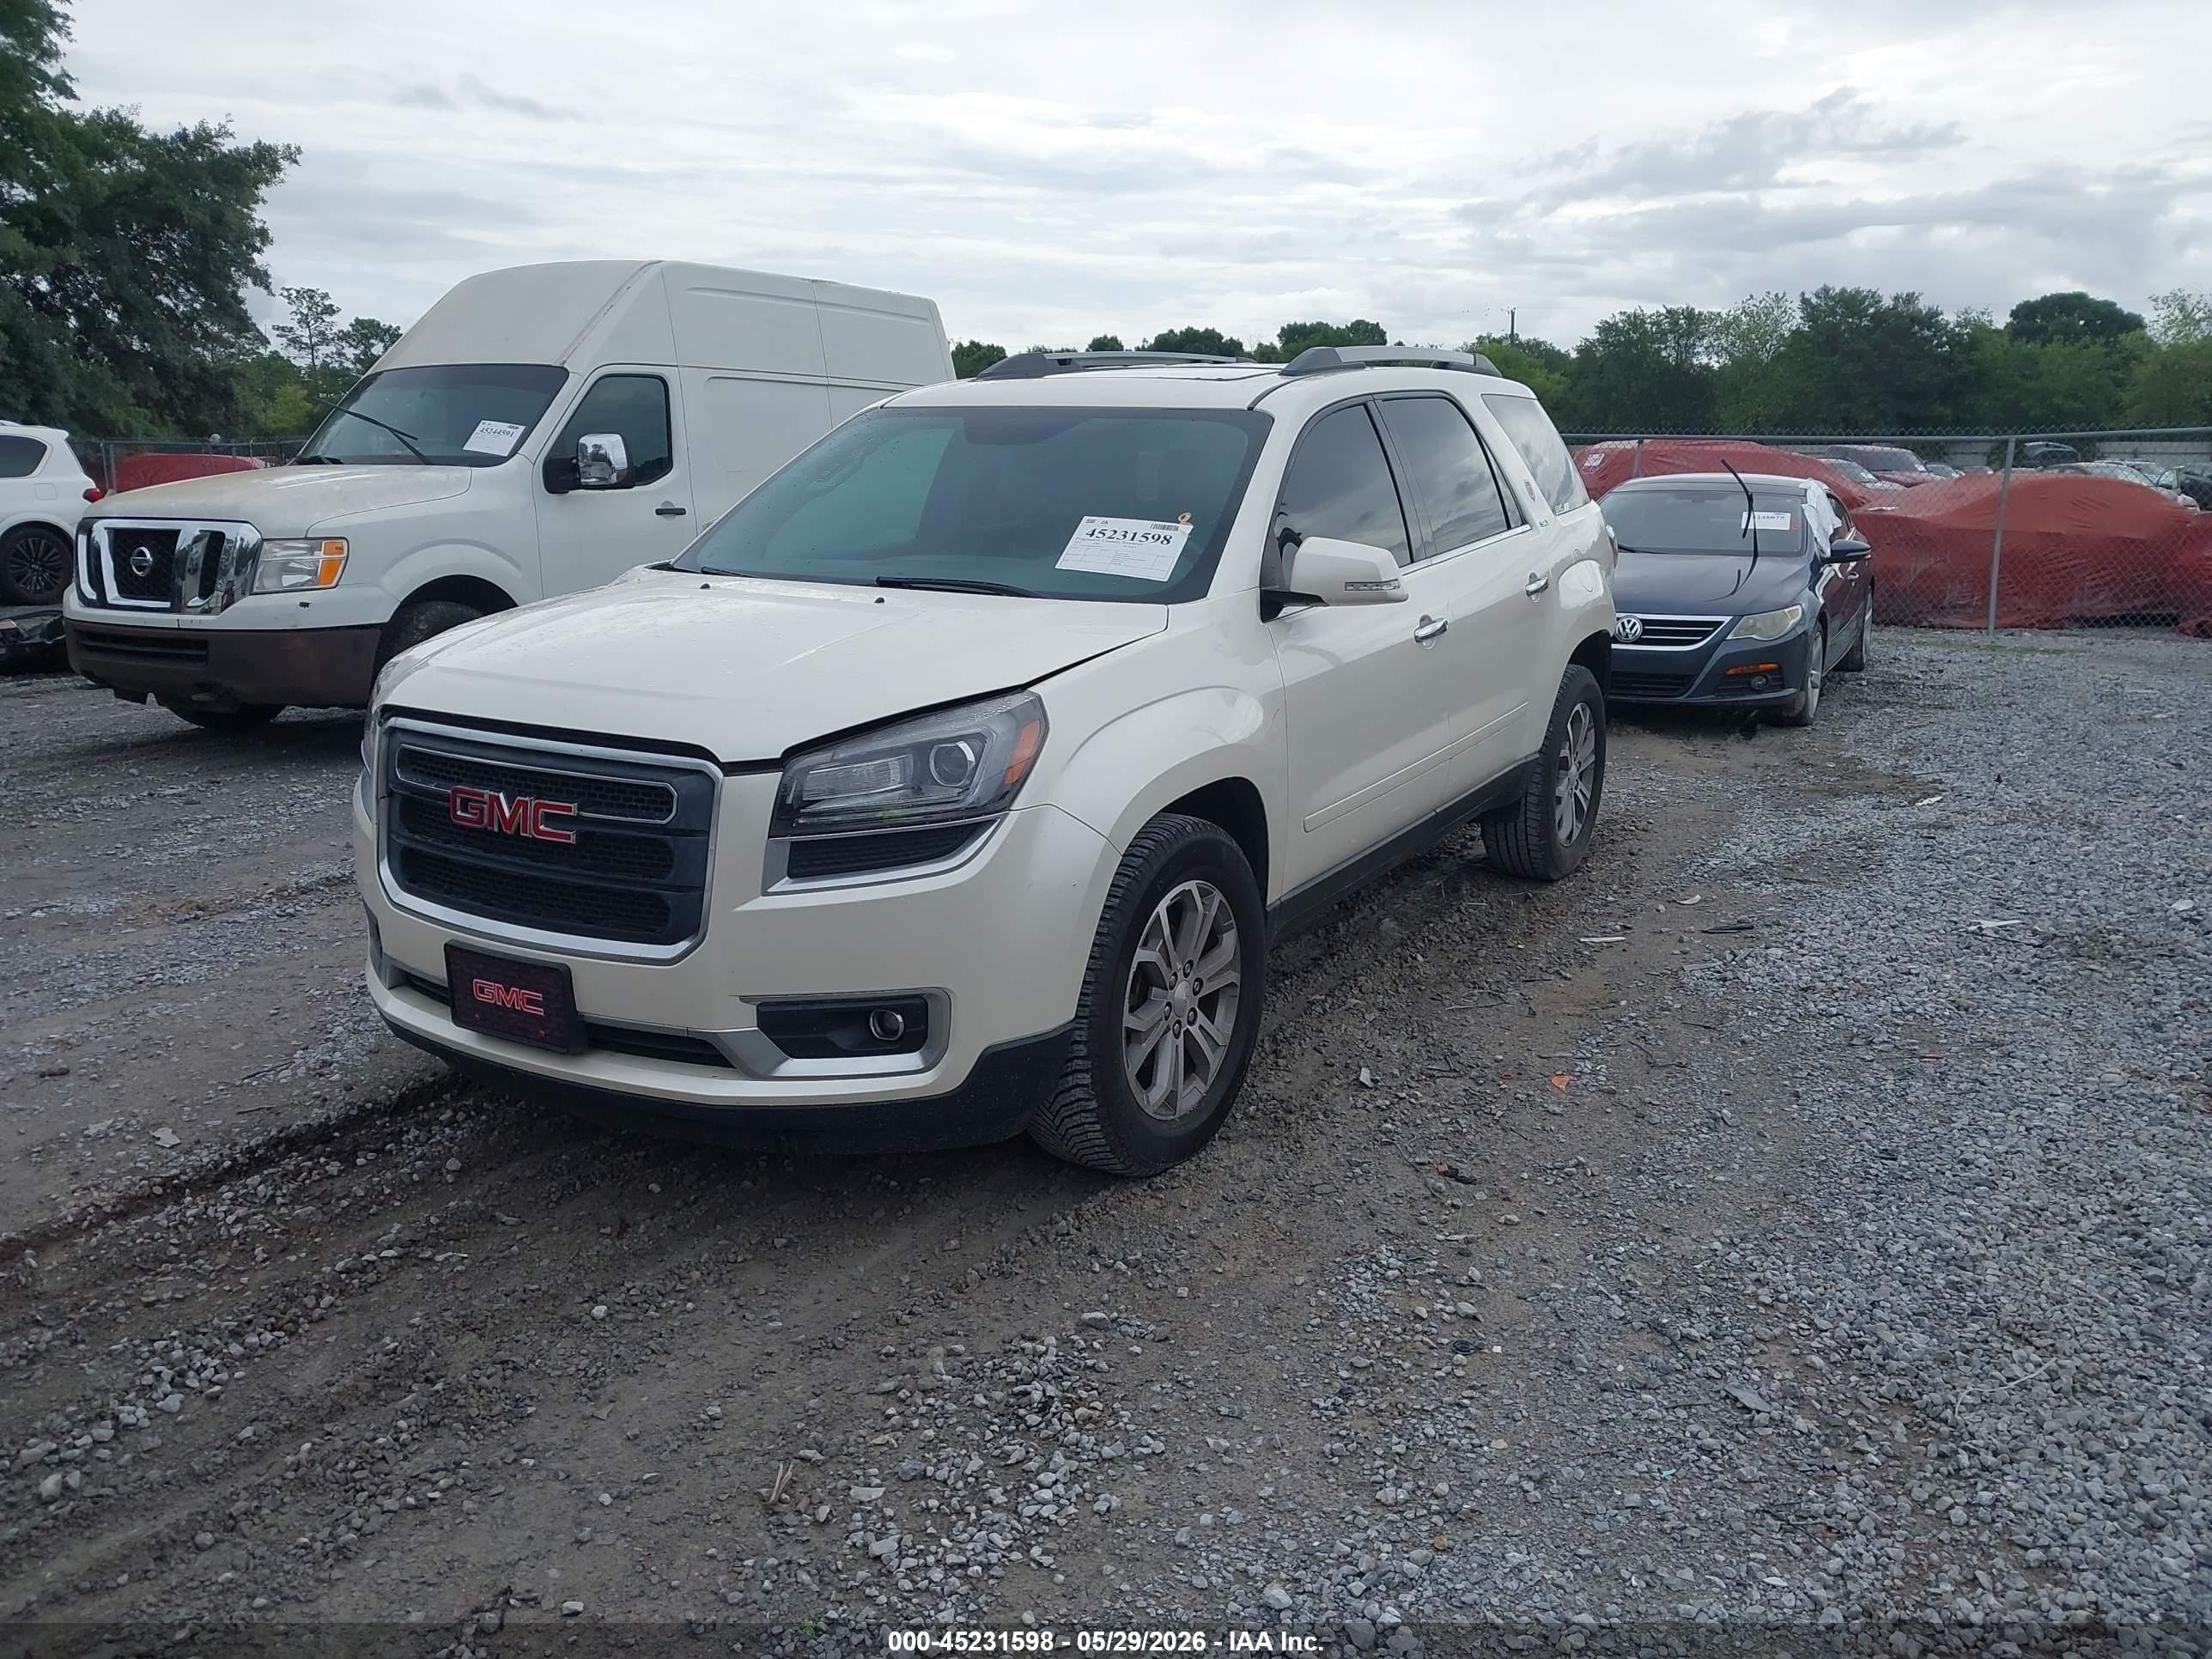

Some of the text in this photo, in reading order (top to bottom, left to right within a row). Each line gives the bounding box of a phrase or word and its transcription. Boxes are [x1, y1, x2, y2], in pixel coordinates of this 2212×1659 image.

[1085, 527, 1173, 545] 45231598
[449, 786, 577, 844] GMC
[472, 978, 544, 1017] GMC
